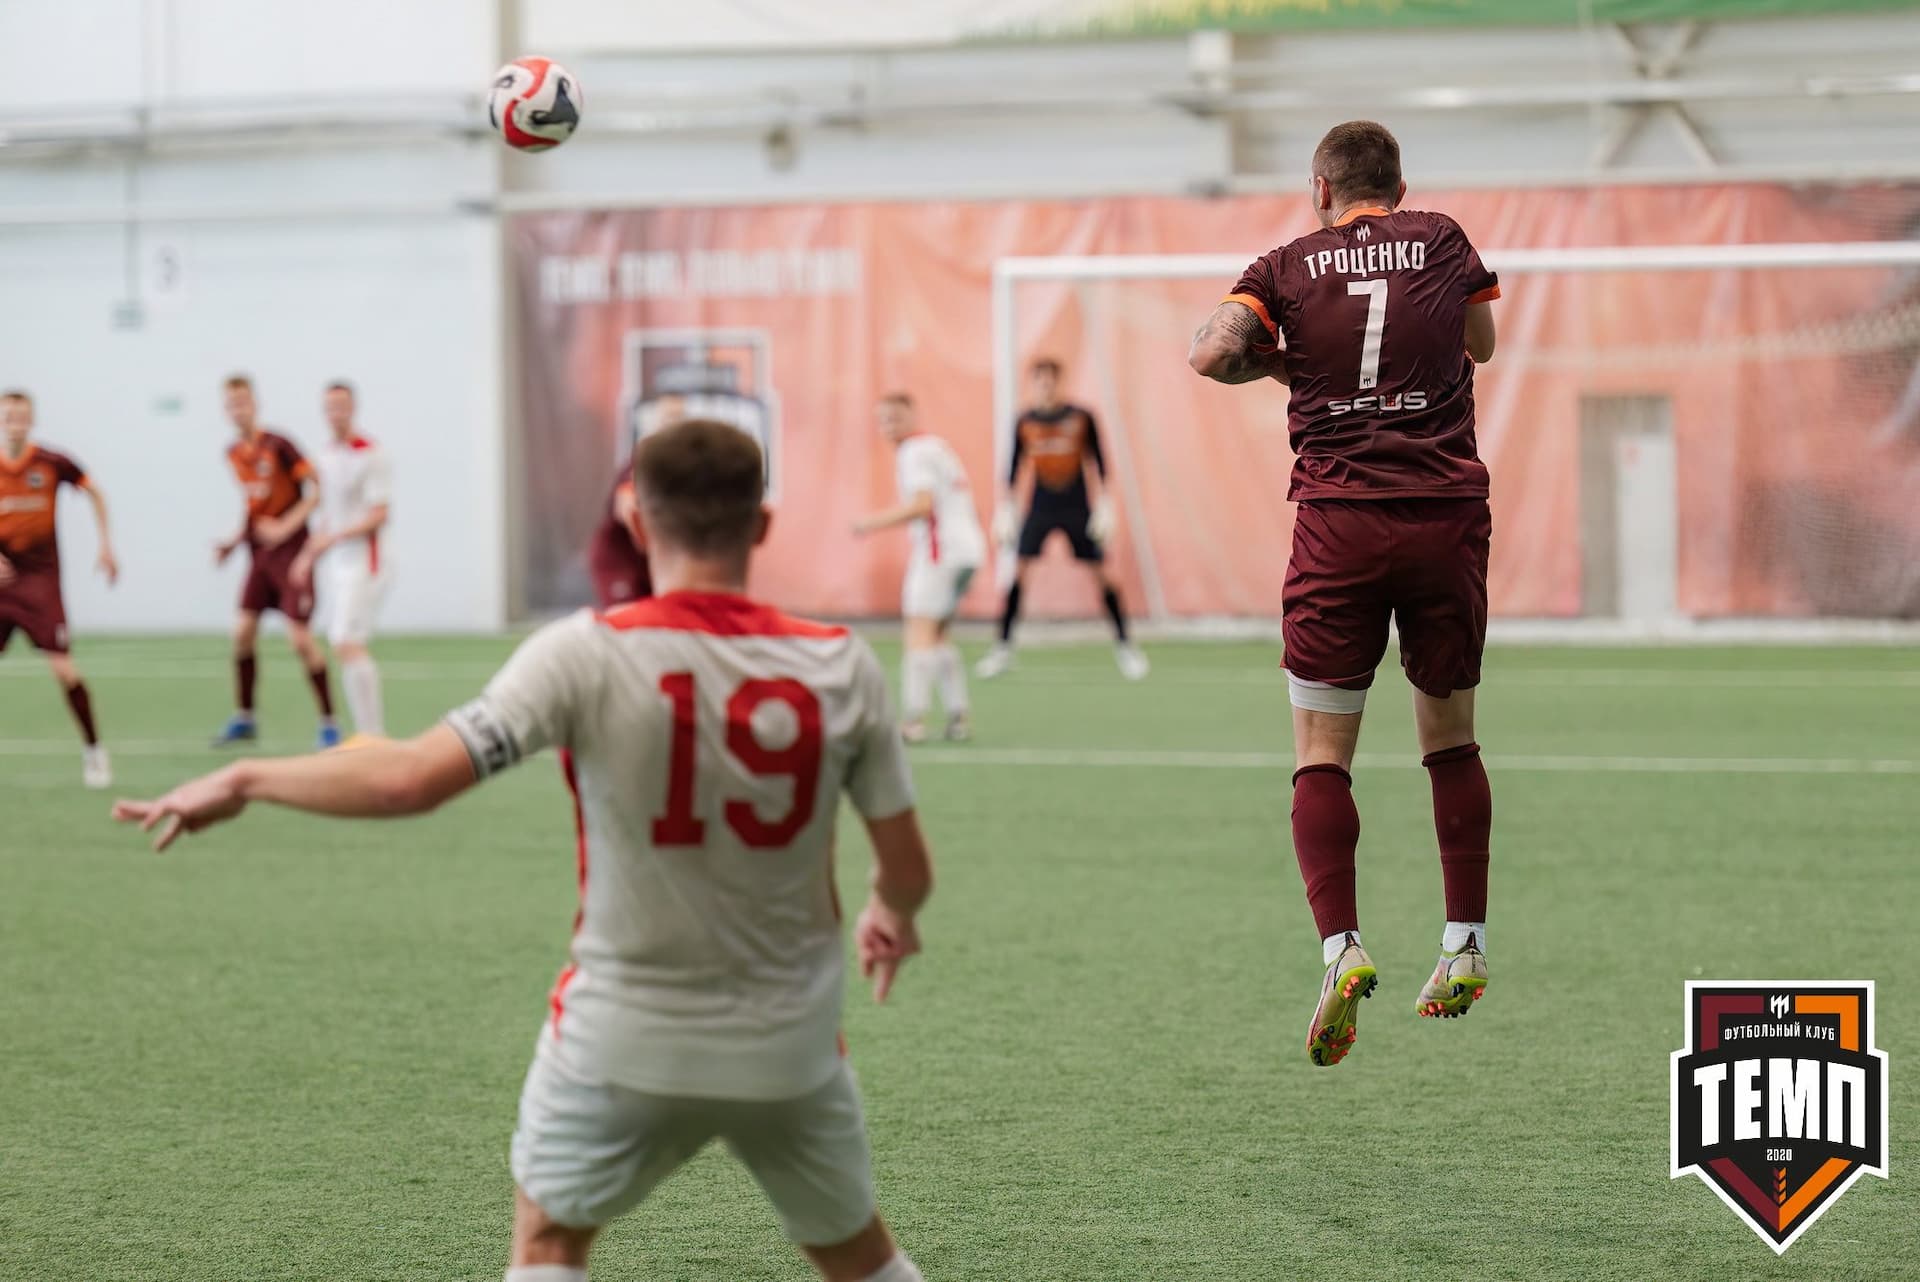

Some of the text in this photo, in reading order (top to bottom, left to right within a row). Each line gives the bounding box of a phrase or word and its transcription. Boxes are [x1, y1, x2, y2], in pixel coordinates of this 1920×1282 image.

[1304, 241, 1426, 279] ТРОЦЕНКО
[1347, 279, 1388, 389] 7
[1327, 391, 1428, 416] SEUS
[650, 670, 822, 851] 19
